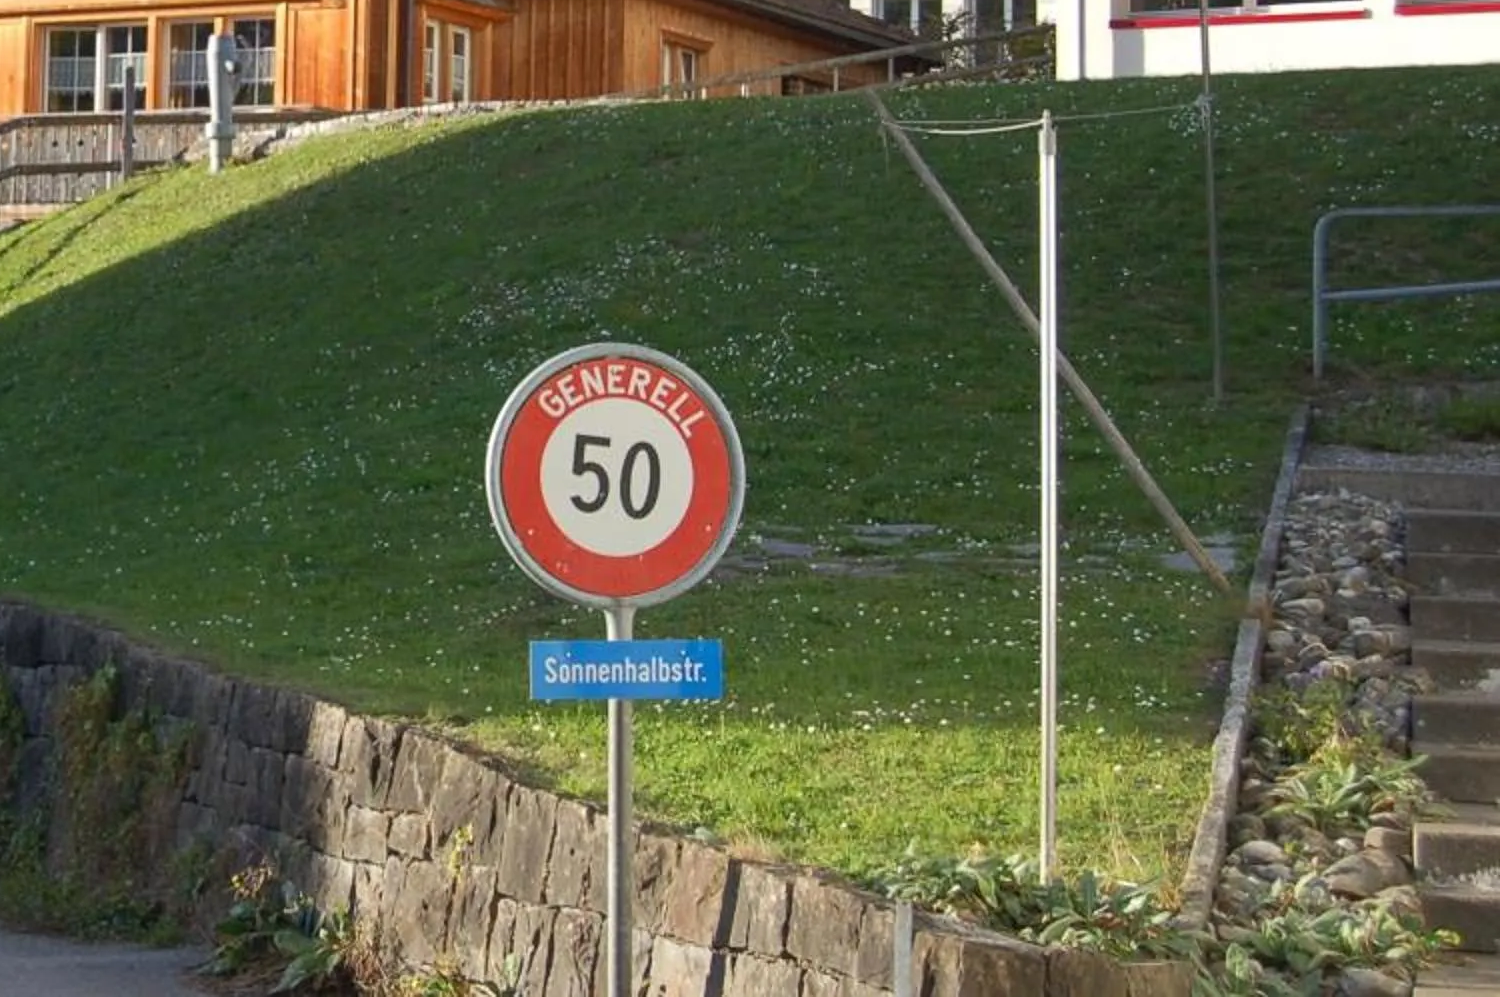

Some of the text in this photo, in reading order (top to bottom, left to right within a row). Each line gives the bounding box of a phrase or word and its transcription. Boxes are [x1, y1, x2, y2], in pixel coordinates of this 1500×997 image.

[538, 364, 705, 439] GENERELL
[570, 434, 661, 520] 50
[544, 656, 708, 684] Sonnenhalbstr.
